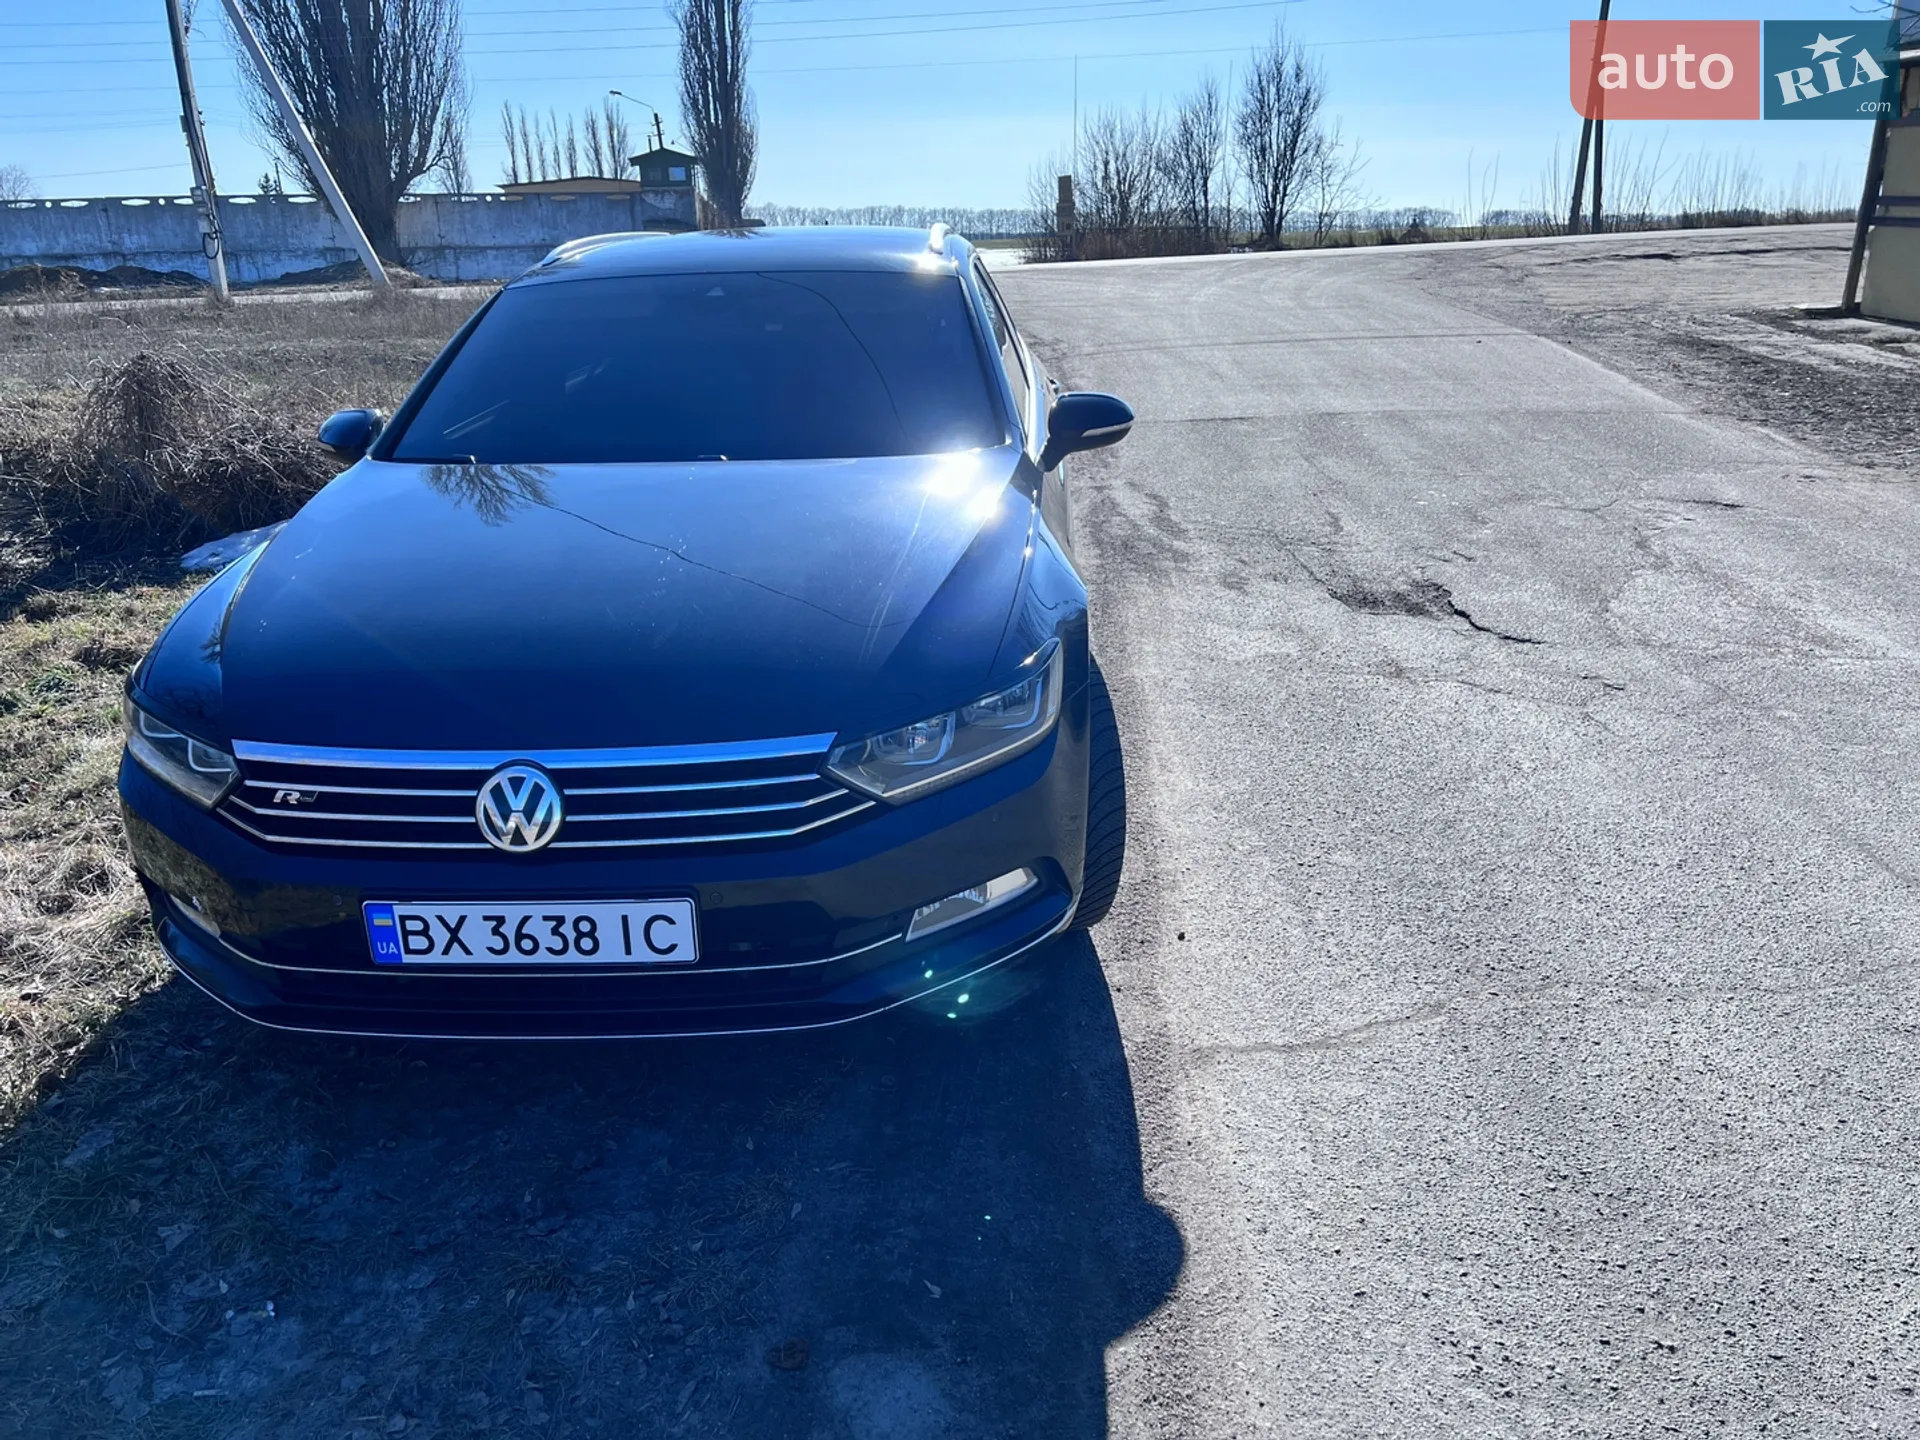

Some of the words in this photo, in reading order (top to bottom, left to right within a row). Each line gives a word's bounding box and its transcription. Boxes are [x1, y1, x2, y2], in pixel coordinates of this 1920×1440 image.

[377, 941, 399, 955] UA
[398, 914, 474, 956] BX
[481, 914, 601, 956] 3638
[620, 914, 679, 956] IC
